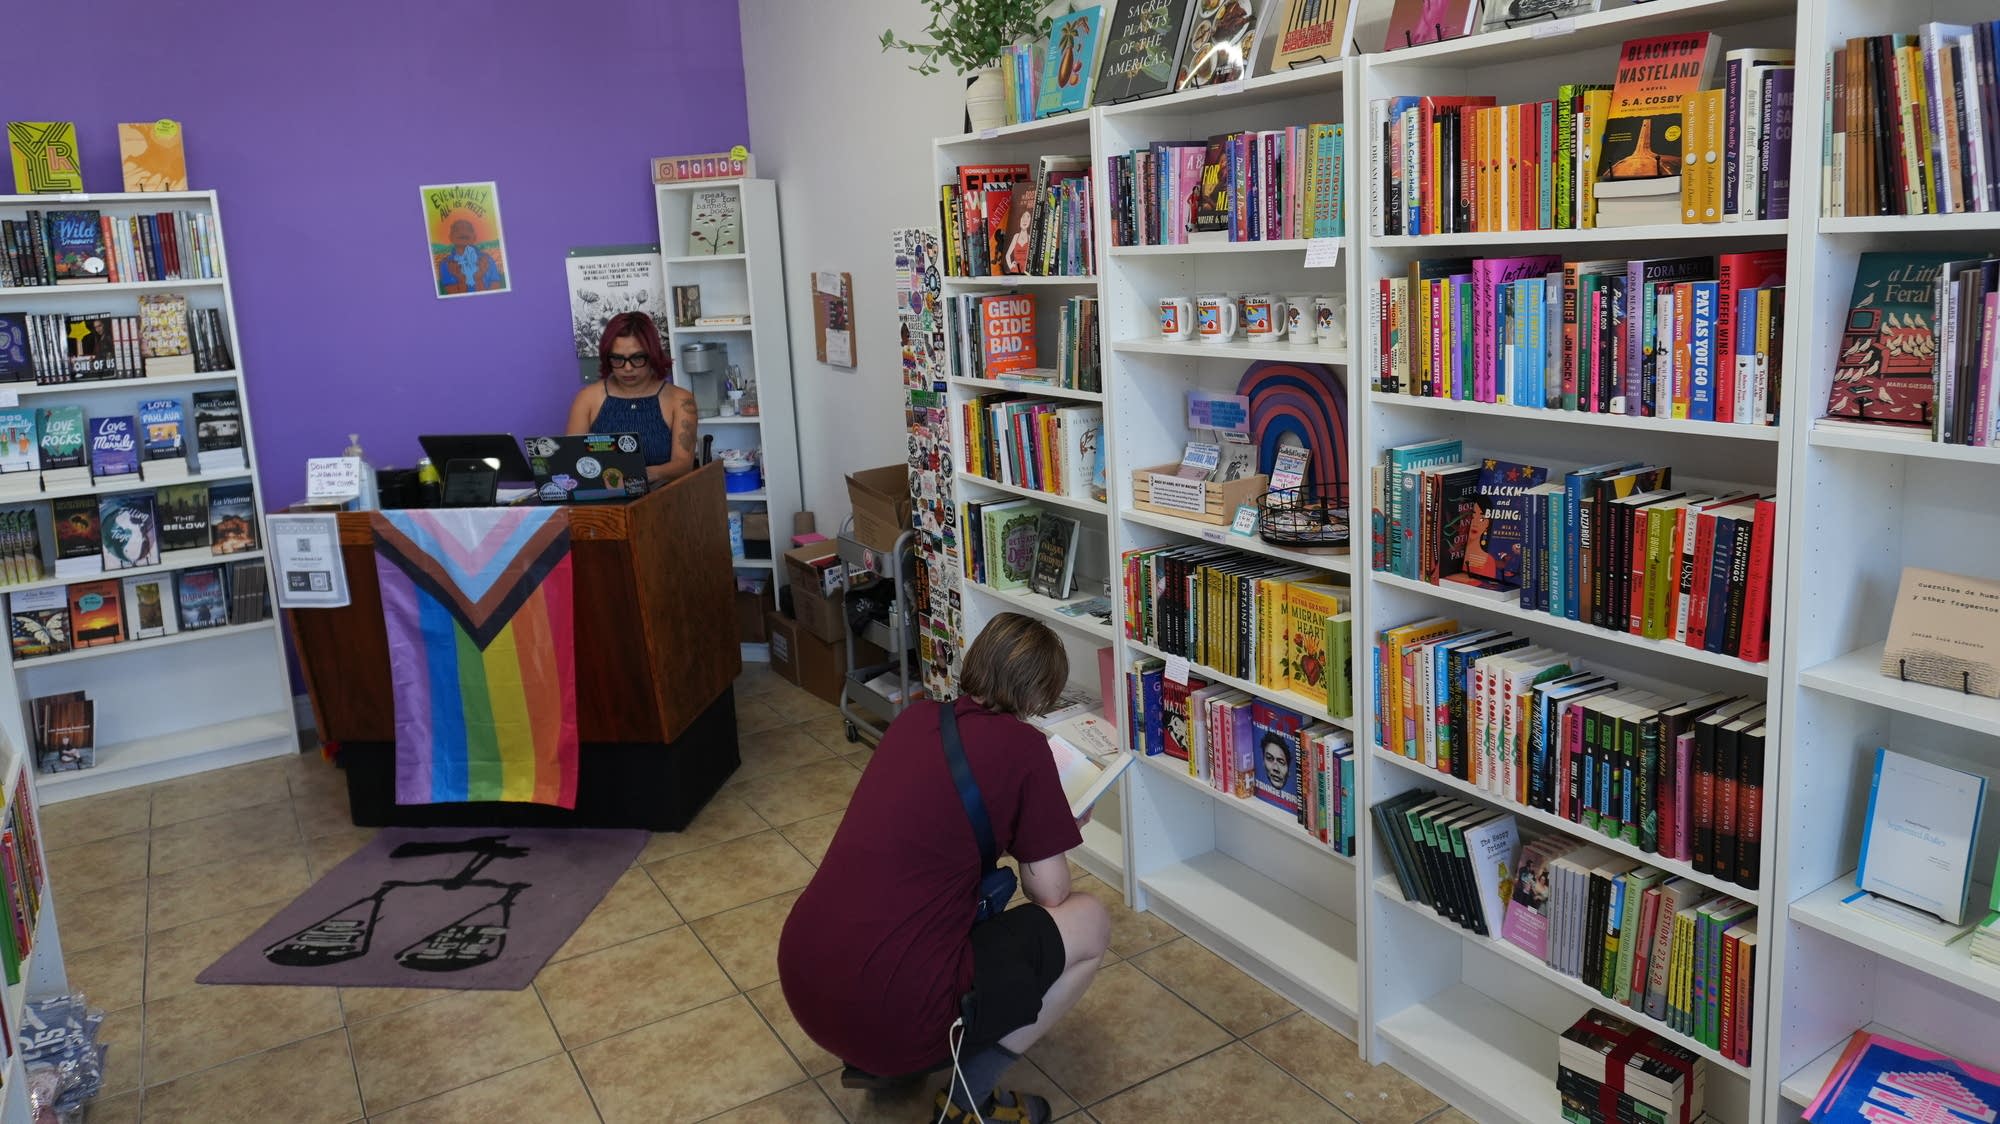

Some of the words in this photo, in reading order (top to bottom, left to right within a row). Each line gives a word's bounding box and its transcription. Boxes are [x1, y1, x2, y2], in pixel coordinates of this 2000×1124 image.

[1128, 0, 1172, 18] SACRED
[1123, 15, 1168, 38] PLANTS
[1120, 41, 1136, 56] OF
[1138, 34, 1162, 50] THE
[1627, 40, 1699, 62] BLACKTOP
[1106, 50, 1167, 77] AMERICAS
[1619, 62, 1700, 84] WASTELAND
[1645, 94, 1682, 104] COSBY
[1764, 79, 1772, 103] MEDEA
[1764, 104, 1772, 122] SANG
[1688, 118, 1696, 151] Strangers
[1763, 124, 1771, 134] ME
[1762, 141, 1770, 171] CORRIDO
[679, 160, 741, 176] 10109
[1203, 164, 1220, 185] FOR
[700, 192, 726, 202] speak
[1332, 156, 1340, 220] FUTBOLISTA
[1408, 178, 1416, 200] Help?
[430, 186, 488, 209] EVENTUALLY
[722, 196, 736, 204] for
[60, 220, 97, 237] Wild
[1501, 265, 1525, 284] Last
[1646, 266, 1674, 279] ZORA
[1720, 266, 1730, 290] BEST
[1888, 270, 1898, 281] a
[1902, 264, 1944, 282] Littl
[1601, 285, 1608, 294] OF
[1884, 284, 1930, 304] Feral
[988, 300, 1031, 316] GENO
[1564, 292, 1574, 321] CHIEF
[1696, 290, 1709, 316] PAY
[1720, 294, 1730, 325] OFFER
[989, 318, 1032, 336] CIDE
[1696, 318, 1709, 337] AS
[1719, 328, 1728, 356] WINS
[1696, 338, 1709, 366] YOU
[74, 360, 90, 371] ONE
[93, 359, 104, 370] OF
[106, 357, 115, 368] US
[1564, 354, 1572, 382] HICKEY
[1696, 368, 1708, 386] GO
[147, 400, 172, 410] LOVE
[46, 420, 75, 433] LOVE
[99, 418, 128, 435] Love
[41, 434, 81, 447] ROCKS
[1392, 463, 1402, 500] AMERICAN
[1481, 485, 1529, 496] BLACKM
[1462, 486, 1479, 496] HER
[173, 515, 196, 523] THE
[1484, 508, 1521, 520] BIBING
[163, 522, 206, 532] BELOW
[1580, 508, 1590, 548] CAZZAROLA!
[1736, 526, 1744, 556] EVELYN
[1681, 560, 1694, 590] 1984
[1732, 558, 1742, 582] HUGO
[1950, 600, 1998, 612] fragmentos
[1297, 624, 1325, 639] HEART
[1164, 700, 1187, 716] NAZIS
[1640, 796, 1646, 805] AT
[1480, 838, 1490, 848] The
[1492, 831, 1510, 844] Happy
[1488, 842, 1507, 854] Prince
[1659, 897, 1674, 946] QUESTIONS
[1658, 949, 1666, 960] 27
[1654, 972, 1662, 985] 28
